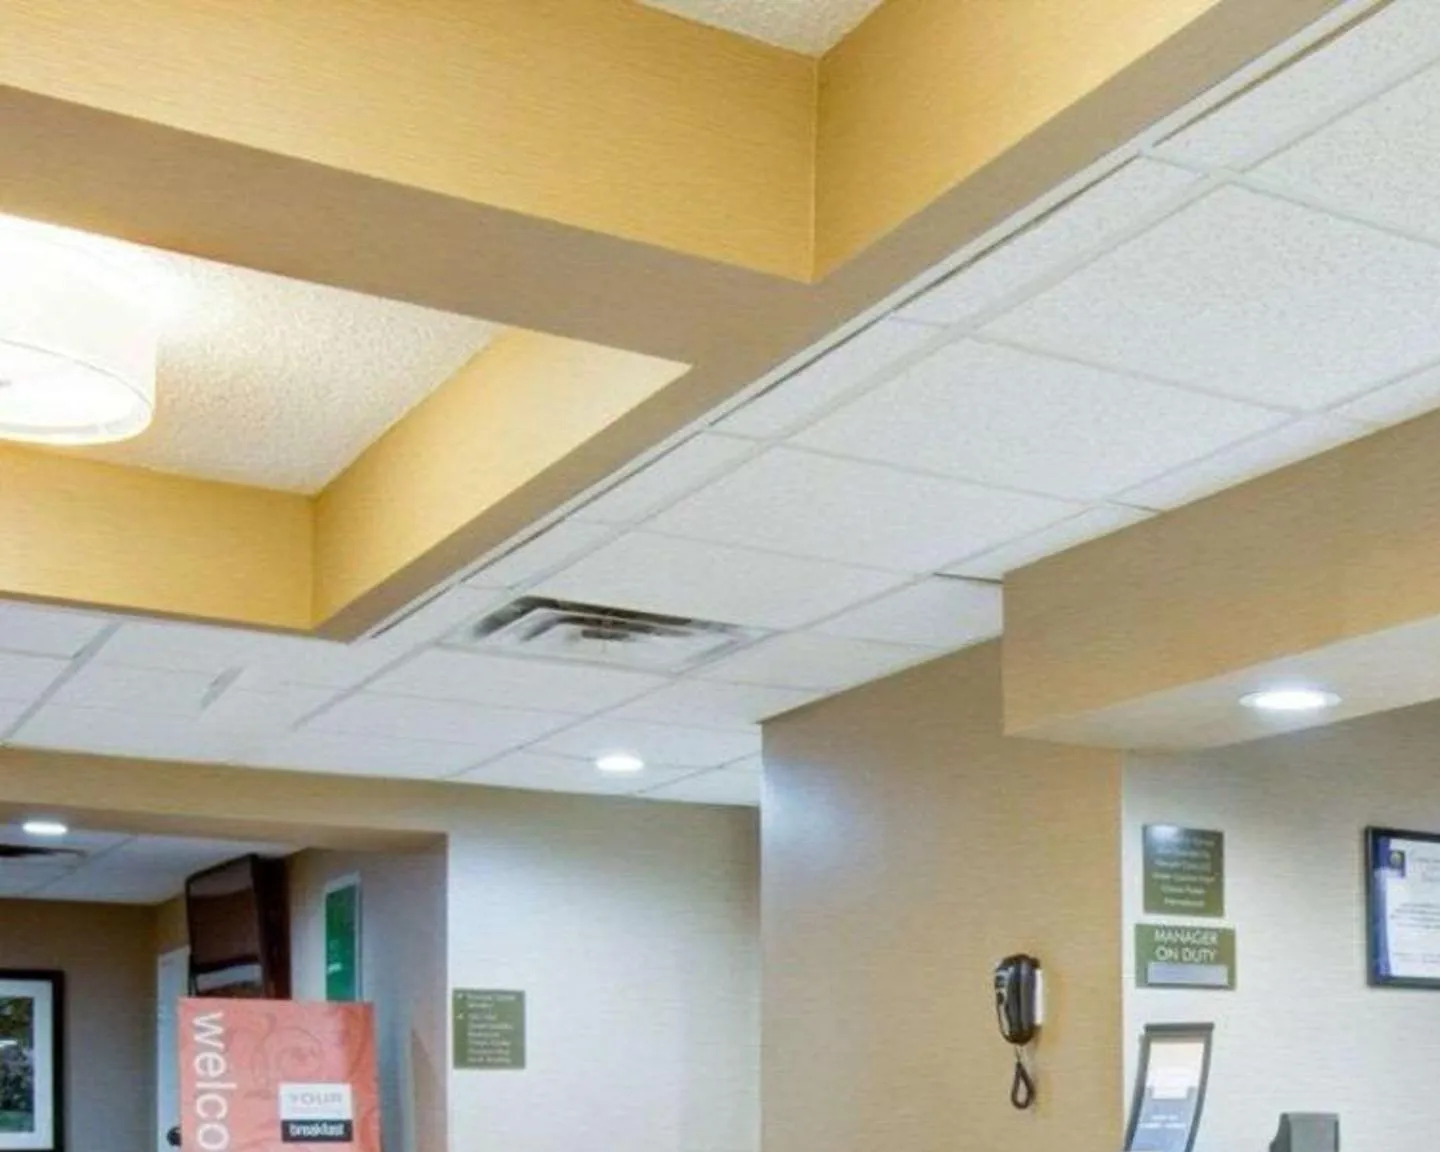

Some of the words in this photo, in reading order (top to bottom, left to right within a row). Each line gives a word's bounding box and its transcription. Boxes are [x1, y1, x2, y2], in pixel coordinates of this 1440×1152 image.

[1154, 928, 1219, 946] MANAGER
[1155, 946, 1179, 962] ON
[1181, 947, 1217, 963] DUTY
